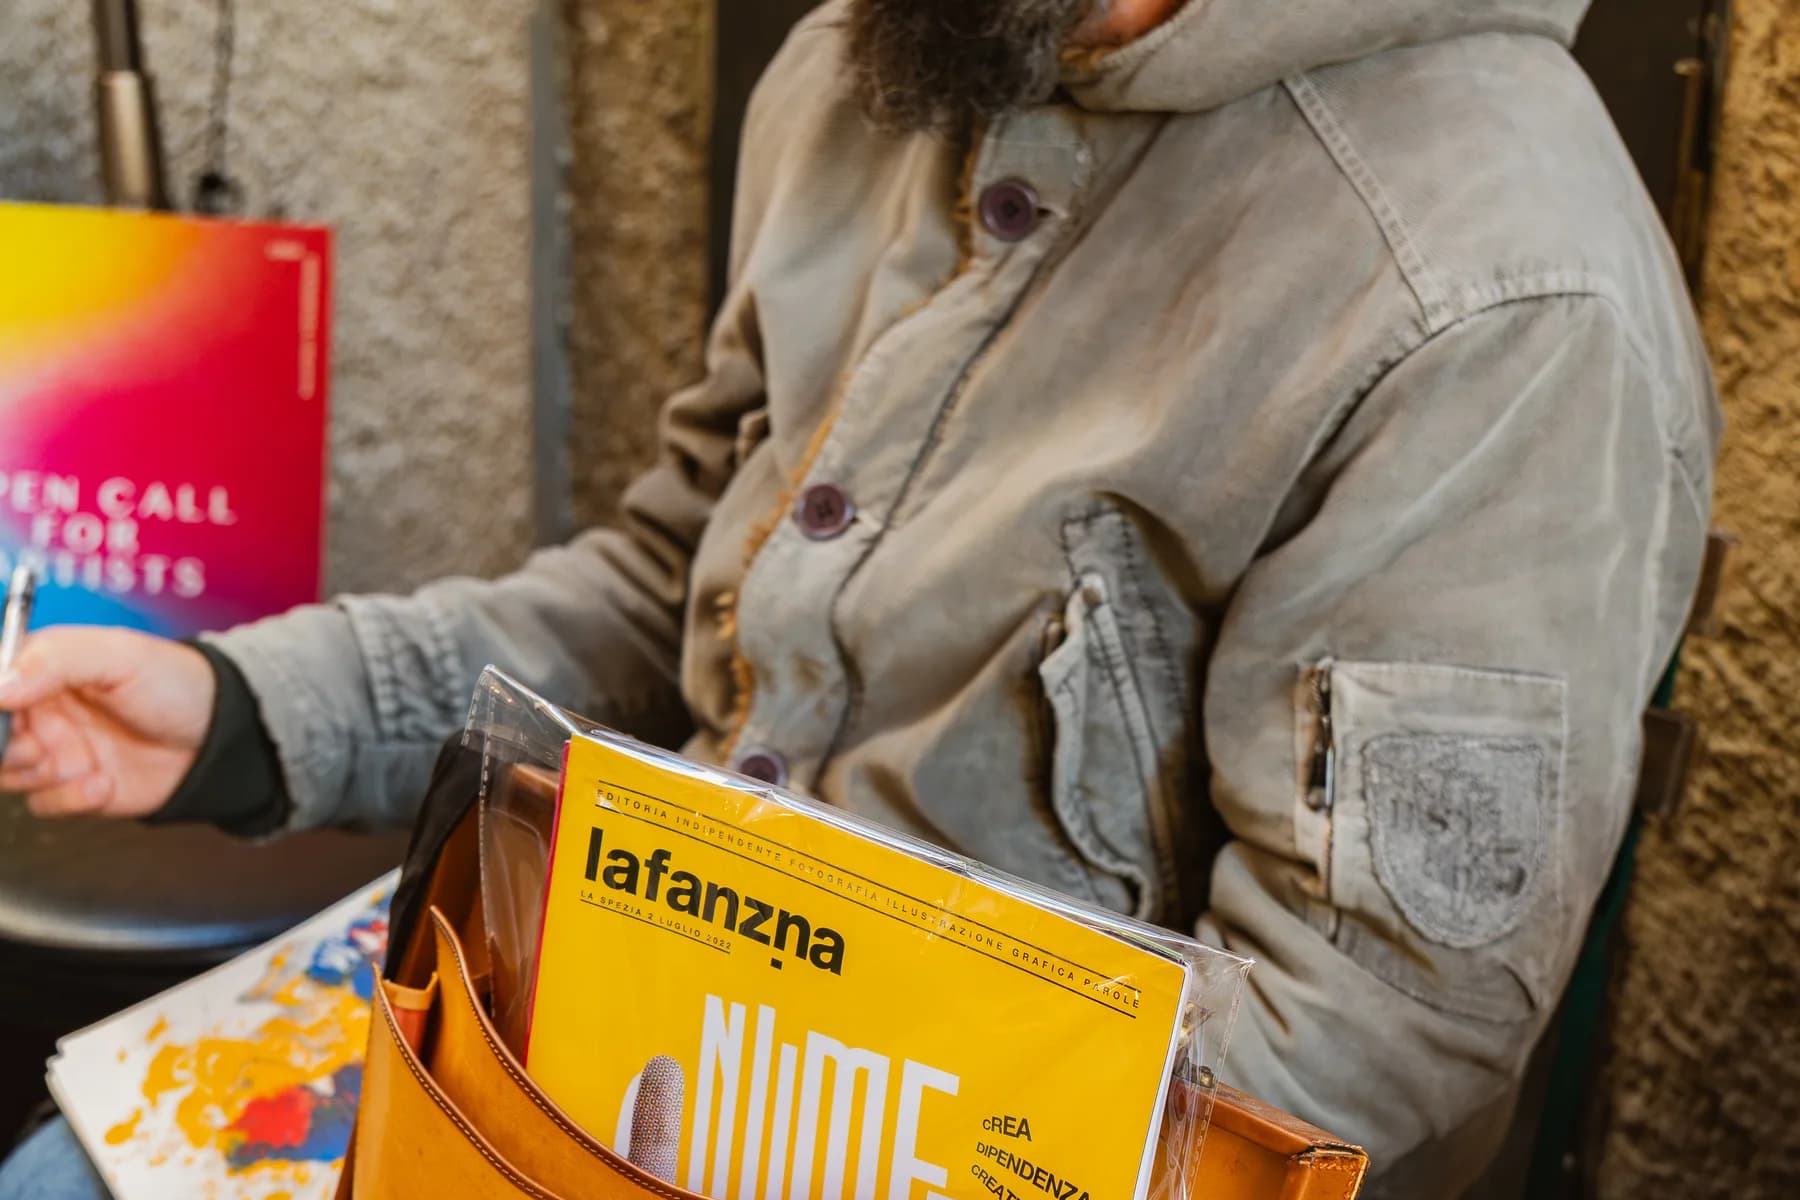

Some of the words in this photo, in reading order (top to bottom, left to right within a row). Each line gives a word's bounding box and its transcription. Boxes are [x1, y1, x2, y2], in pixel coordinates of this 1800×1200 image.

[0, 470, 79, 514] EN
[97, 476, 238, 526] CALL
[31, 511, 140, 556] FOR
[580, 889, 594, 902] LA
[600, 895, 642, 917] SPEZIA
[647, 912, 655, 922] 2
[659, 915, 701, 937] LUGLIO
[706, 933, 732, 950] 2022
[597, 788, 668, 819] EDITORIA
[676, 815, 782, 863] INDIPENDENTE
[789, 858, 879, 902] FOTOGRAFIA
[886, 898, 1003, 951] ILLUSTRAZIONE
[1011, 947, 1076, 981] GRAFICA
[1083, 978, 1141, 1009] PAROLE
[982, 1115, 1032, 1142] CREA
